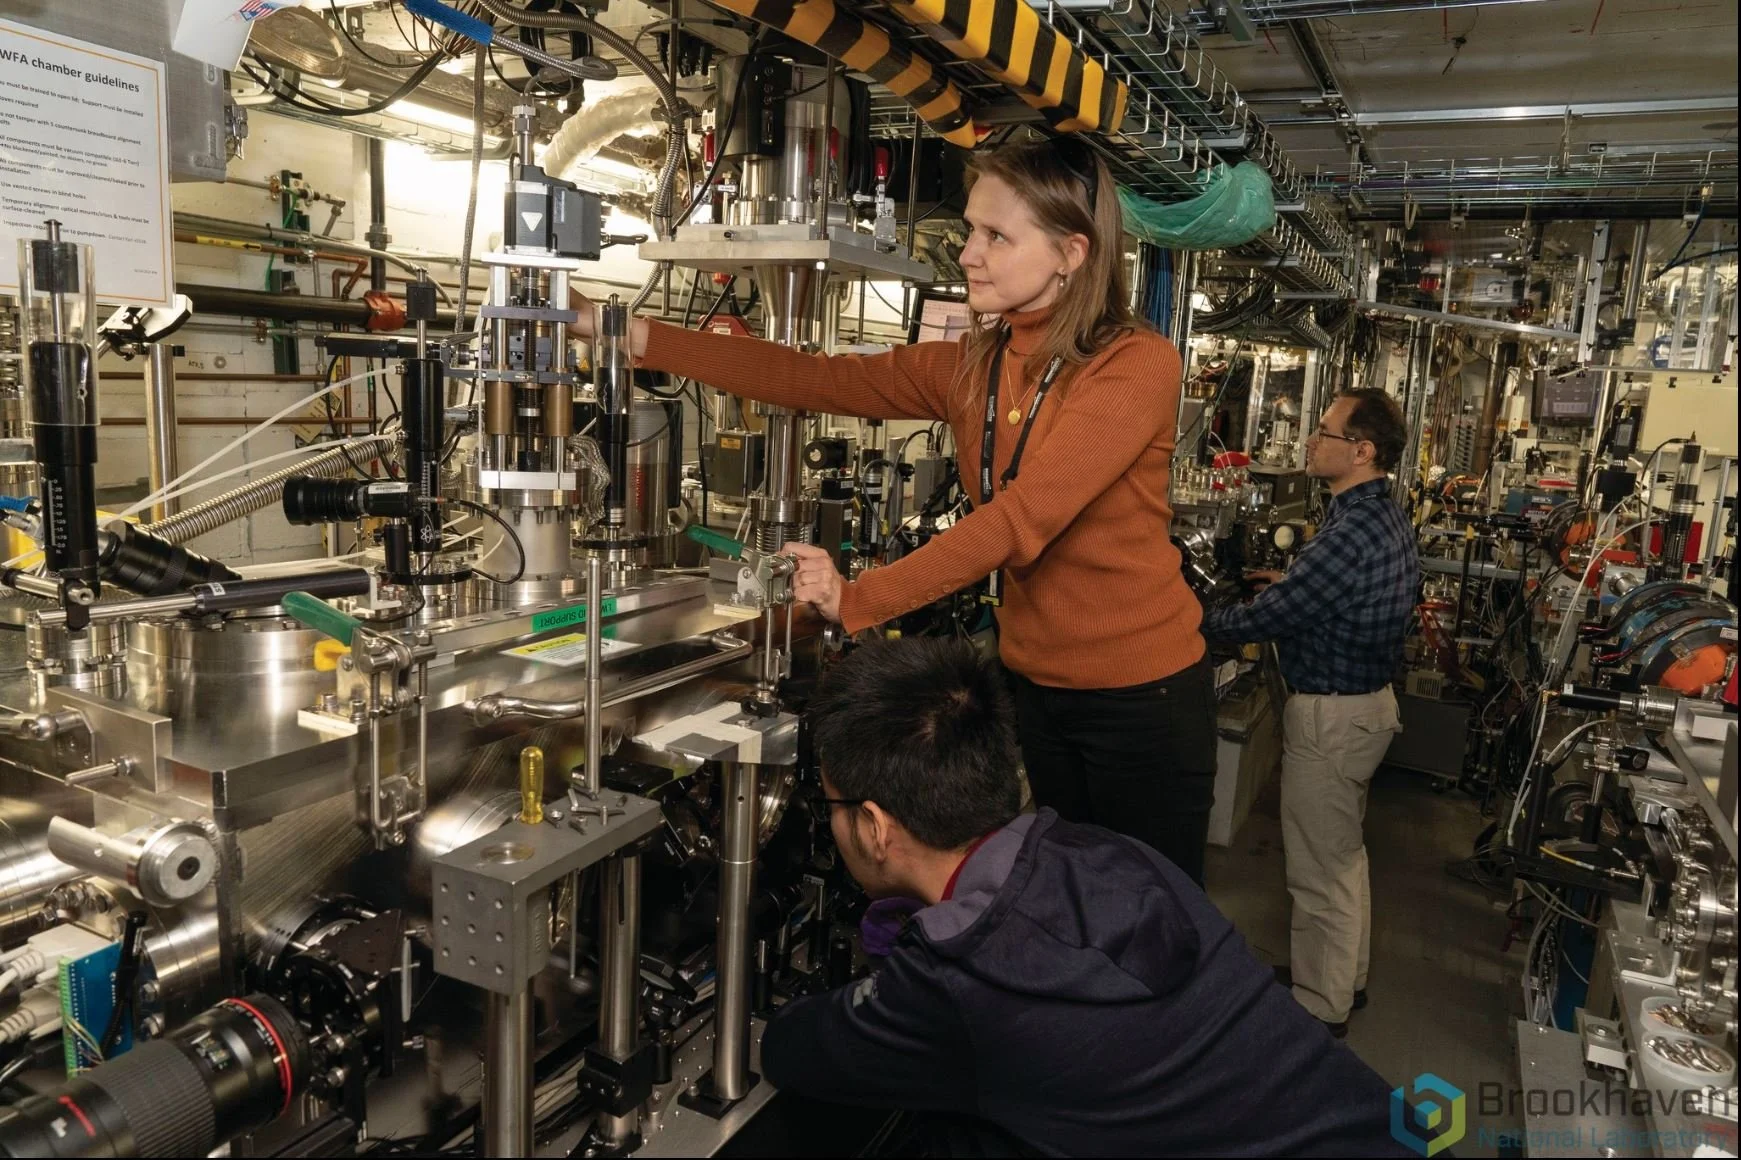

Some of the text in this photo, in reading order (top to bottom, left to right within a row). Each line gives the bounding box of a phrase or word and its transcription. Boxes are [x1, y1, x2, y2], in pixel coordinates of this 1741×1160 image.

[32, 57, 81, 78] chamber
[85, 73, 139, 92] guidelines
[539, 611, 576, 628] SUPPORT
